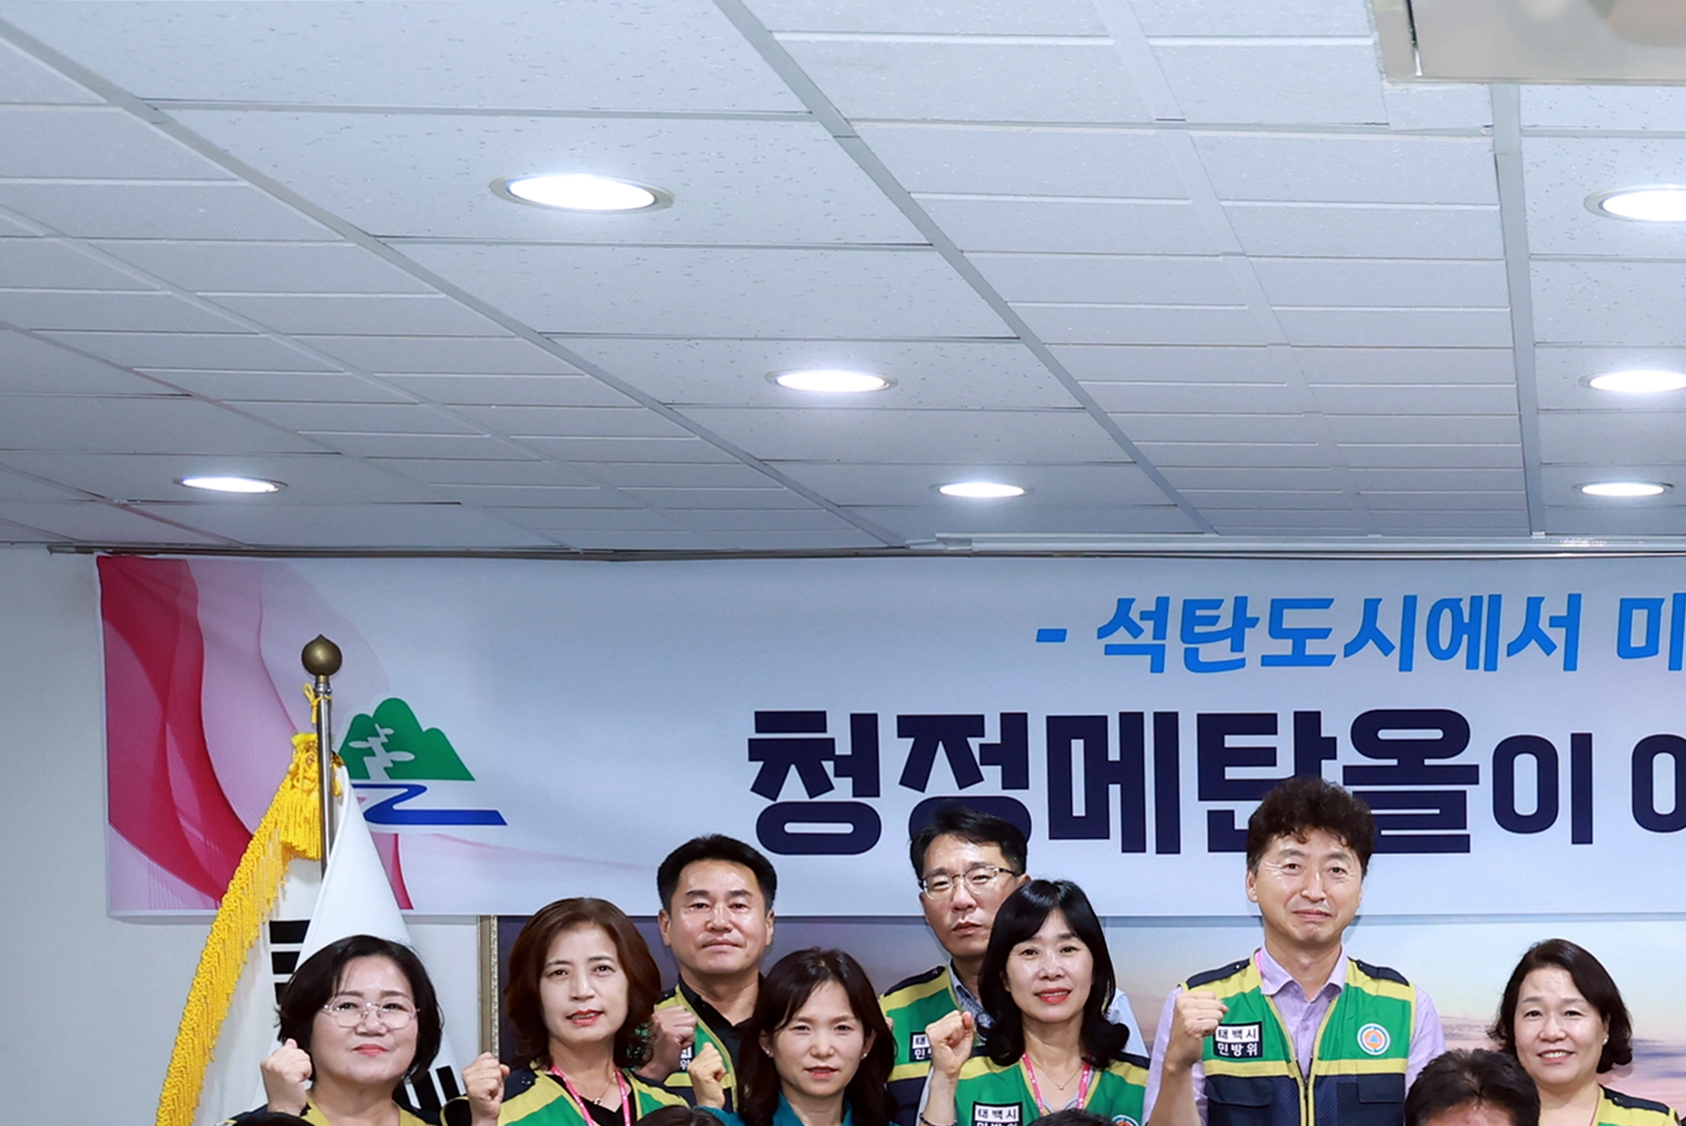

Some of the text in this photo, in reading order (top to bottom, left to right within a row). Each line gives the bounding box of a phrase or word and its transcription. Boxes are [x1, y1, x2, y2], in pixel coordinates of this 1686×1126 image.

[1097, 593, 1582, 674] 석탄도시에서
[748, 709, 1593, 855] 청정메탄올이
[1217, 1042, 1258, 1057] 민방위
